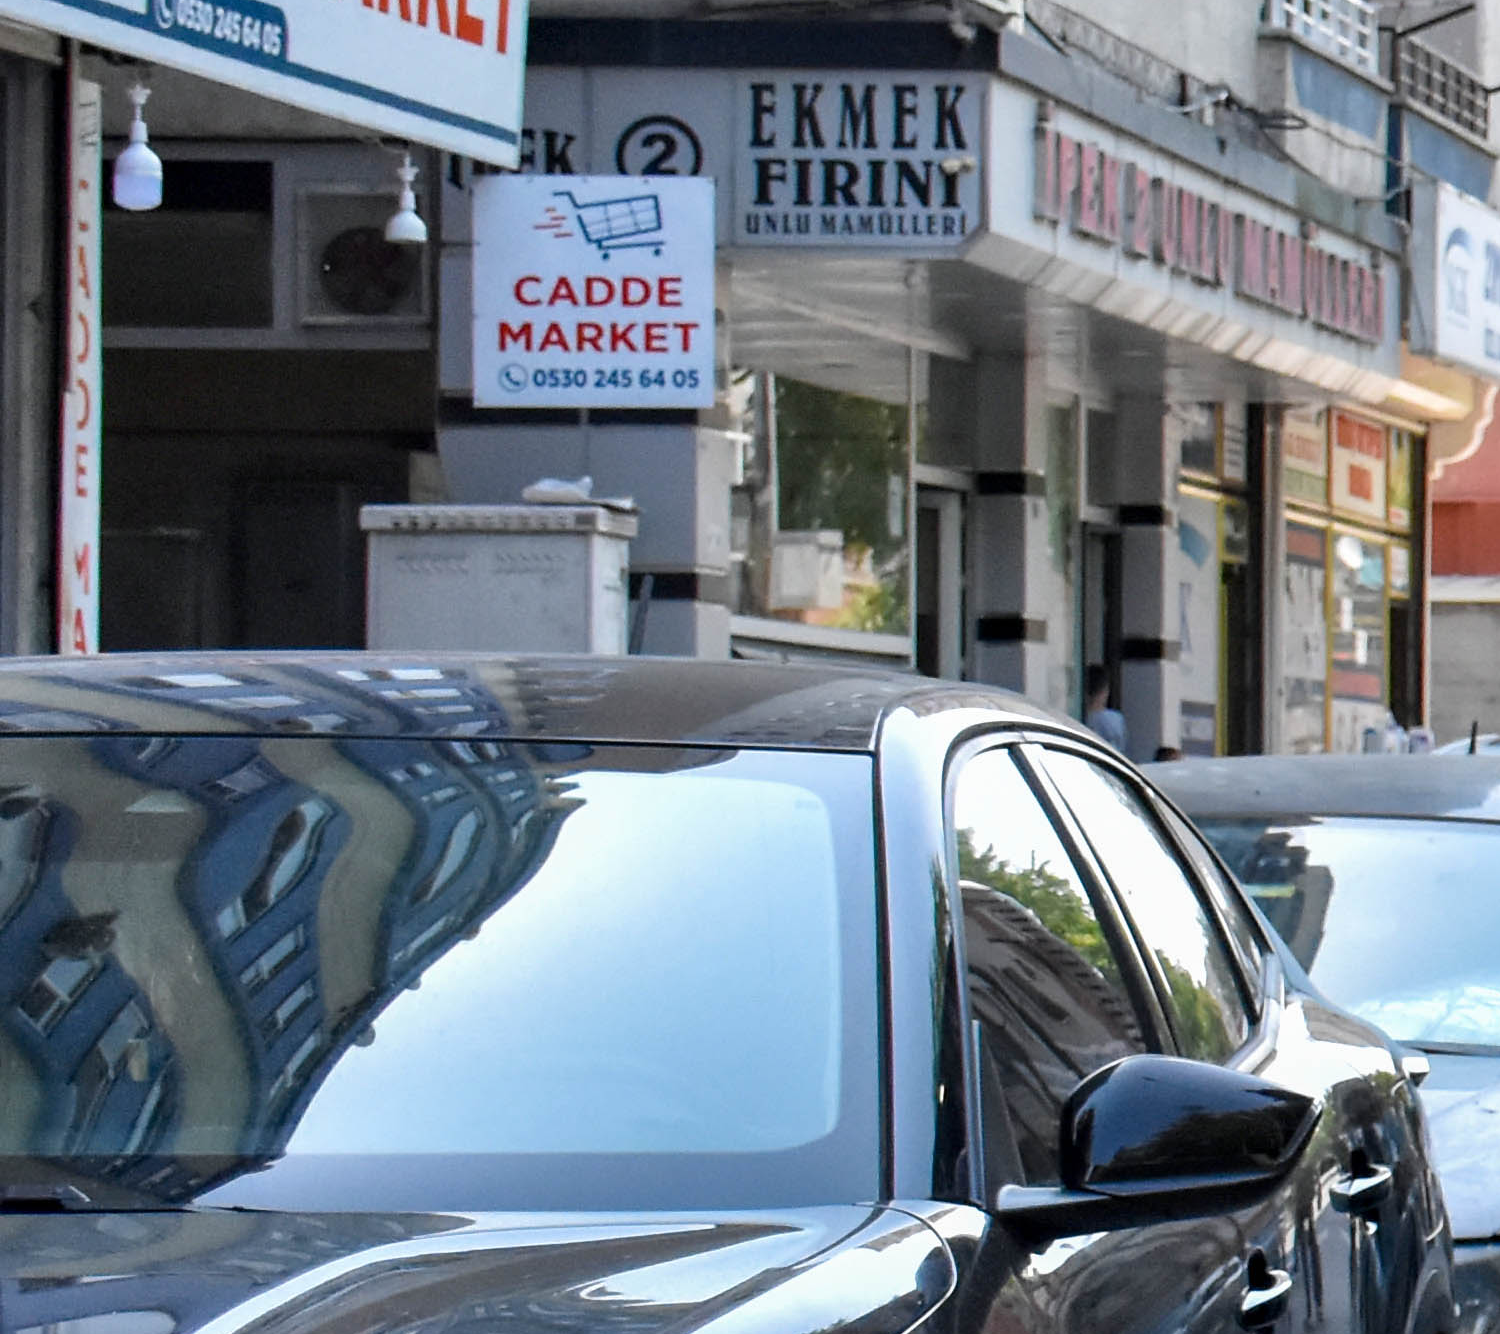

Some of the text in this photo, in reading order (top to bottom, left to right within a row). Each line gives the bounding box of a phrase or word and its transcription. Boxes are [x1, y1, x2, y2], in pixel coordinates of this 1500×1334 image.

[214, 7, 242, 44] 245
[242, 16, 262, 50] 64
[262, 21, 282, 57] 05
[750, 83, 967, 149] EKMEK
[642, 133, 677, 175] 2
[514, 276, 682, 307] CADDE
[498, 322, 700, 353] MARKET
[532, 369, 700, 388] 0530 245 64 05
